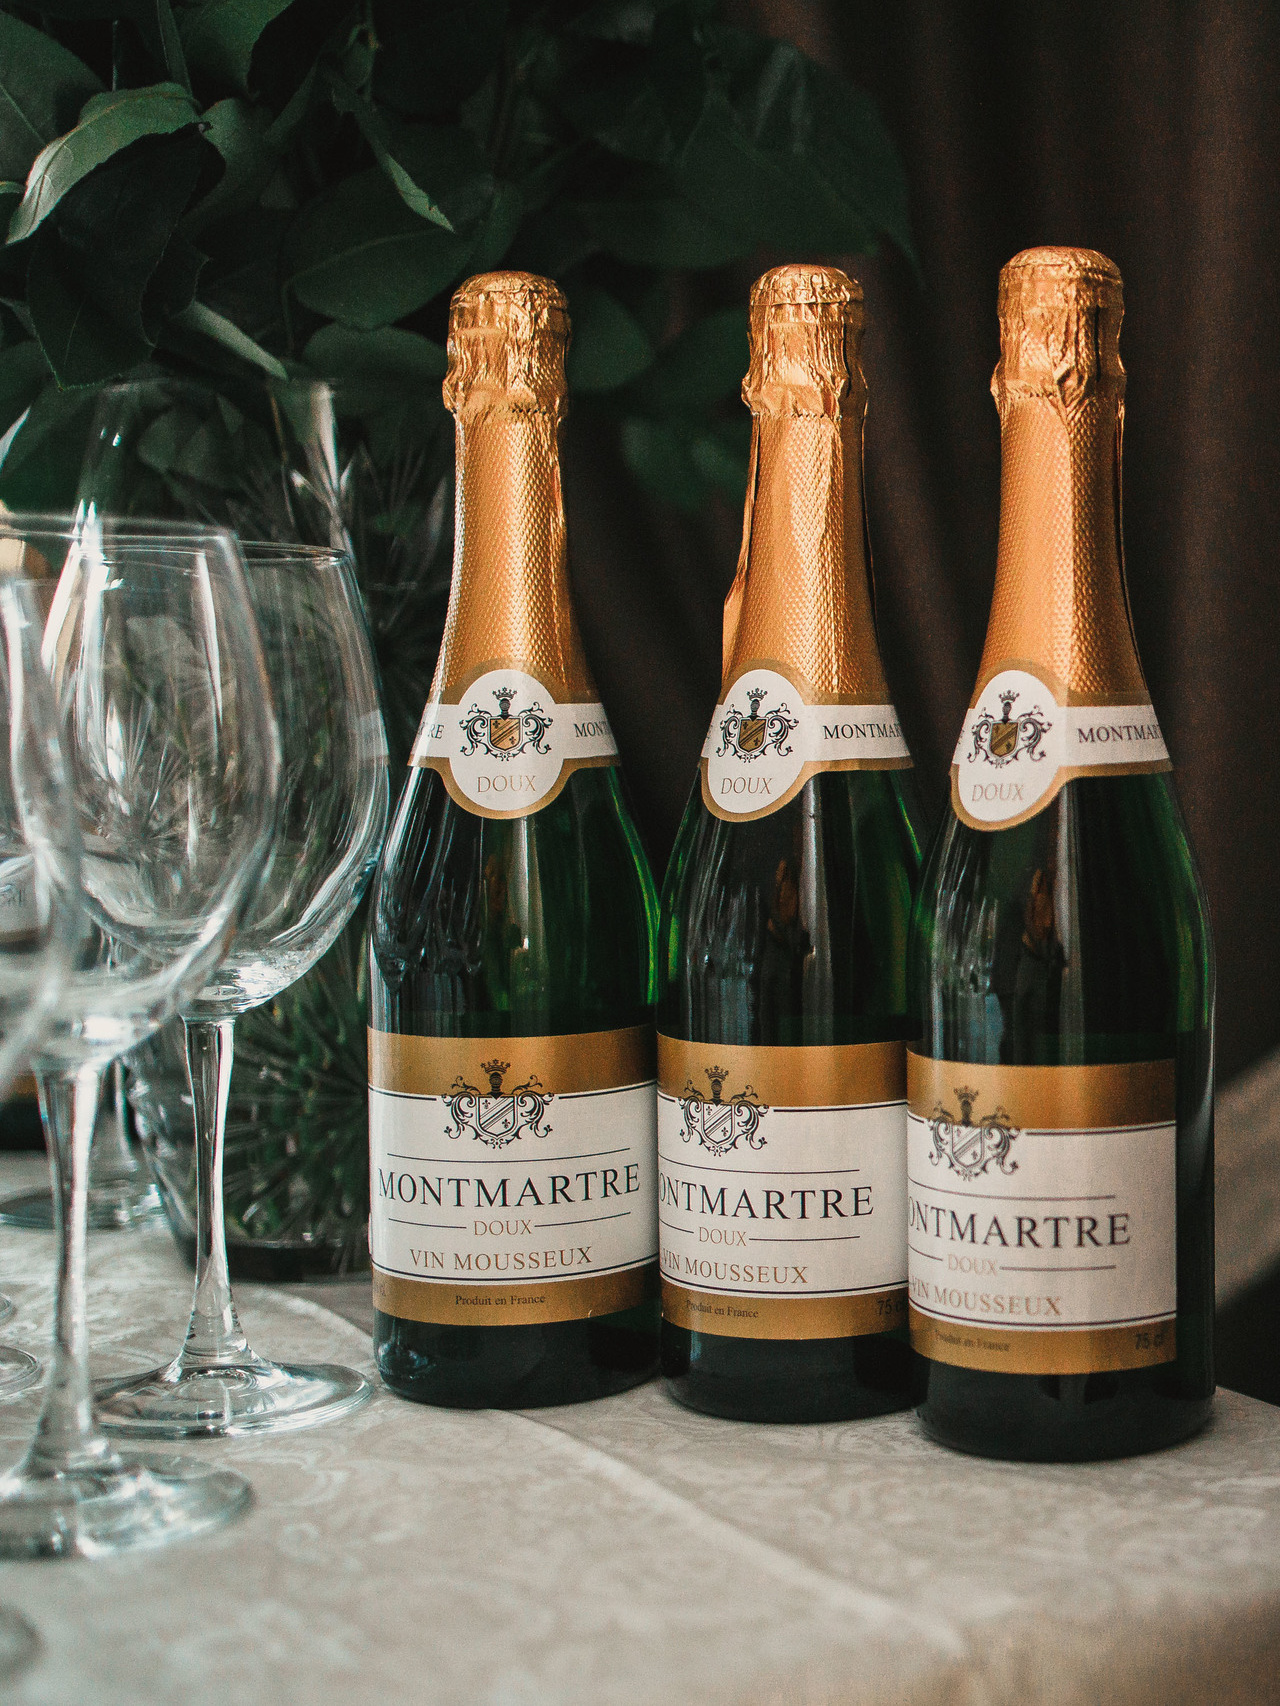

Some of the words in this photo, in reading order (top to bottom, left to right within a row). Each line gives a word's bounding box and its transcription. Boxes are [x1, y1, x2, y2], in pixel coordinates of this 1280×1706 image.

[823, 723, 901, 740] MONTMAR
[477, 775, 536, 793] DOUX
[721, 776, 772, 795] DOUX
[971, 782, 1025, 802] DOUX
[378, 1163, 641, 1207] MONTMARTRE
[660, 1172, 874, 1220] ONTMARTRE
[473, 1219, 533, 1236] DOUX
[909, 1196, 1131, 1249] ONTMARTRE
[699, 1226, 747, 1247] DOUX
[410, 1248, 444, 1269] VIN
[454, 1246, 593, 1271] MOUSSEUX
[948, 1253, 998, 1276] DOUX
[685, 1256, 808, 1284] MOUSSEUX
[456, 1295, 491, 1306] Produit
[494, 1297, 507, 1306] en
[510, 1295, 546, 1305] France
[934, 1286, 1062, 1316] MOUSSEUX
[714, 1306, 725, 1316] en
[727, 1306, 759, 1318] France
